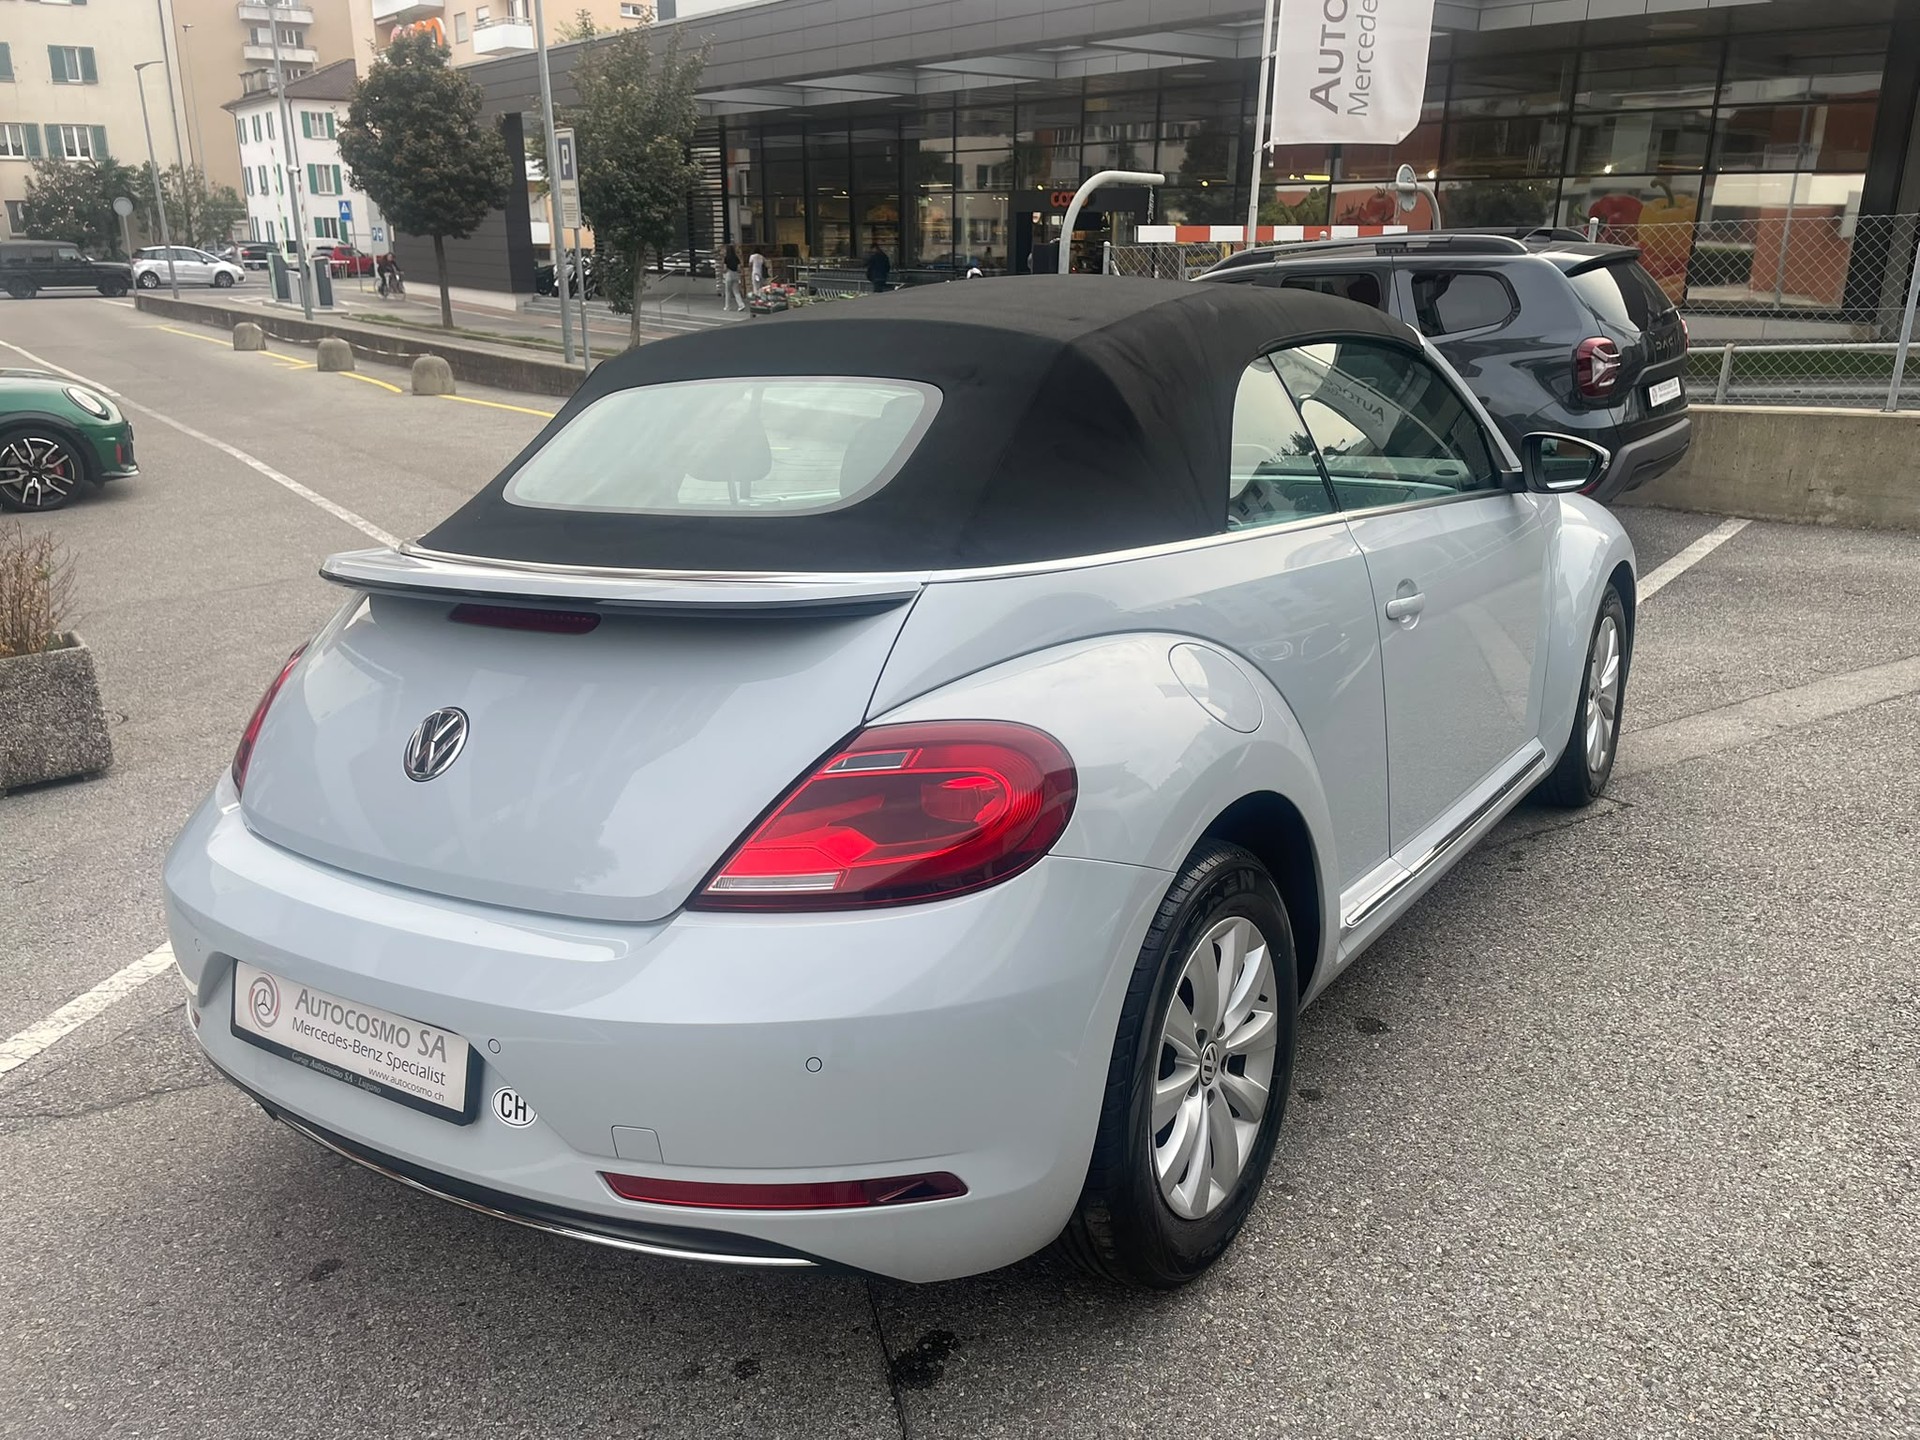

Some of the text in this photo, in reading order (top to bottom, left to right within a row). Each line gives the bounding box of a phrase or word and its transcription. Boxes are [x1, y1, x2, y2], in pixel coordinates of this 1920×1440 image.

[1347, 0, 1378, 116] Mercede
[561, 144, 570, 176] P
[292, 1017, 446, 1086] Mercedes-Benz Specialist
[417, 1029, 447, 1063] SA
[344, 1072, 353, 1083] SA
[368, 1066, 445, 1102] www.autocosmo.ch
[501, 1092, 527, 1122] CH
